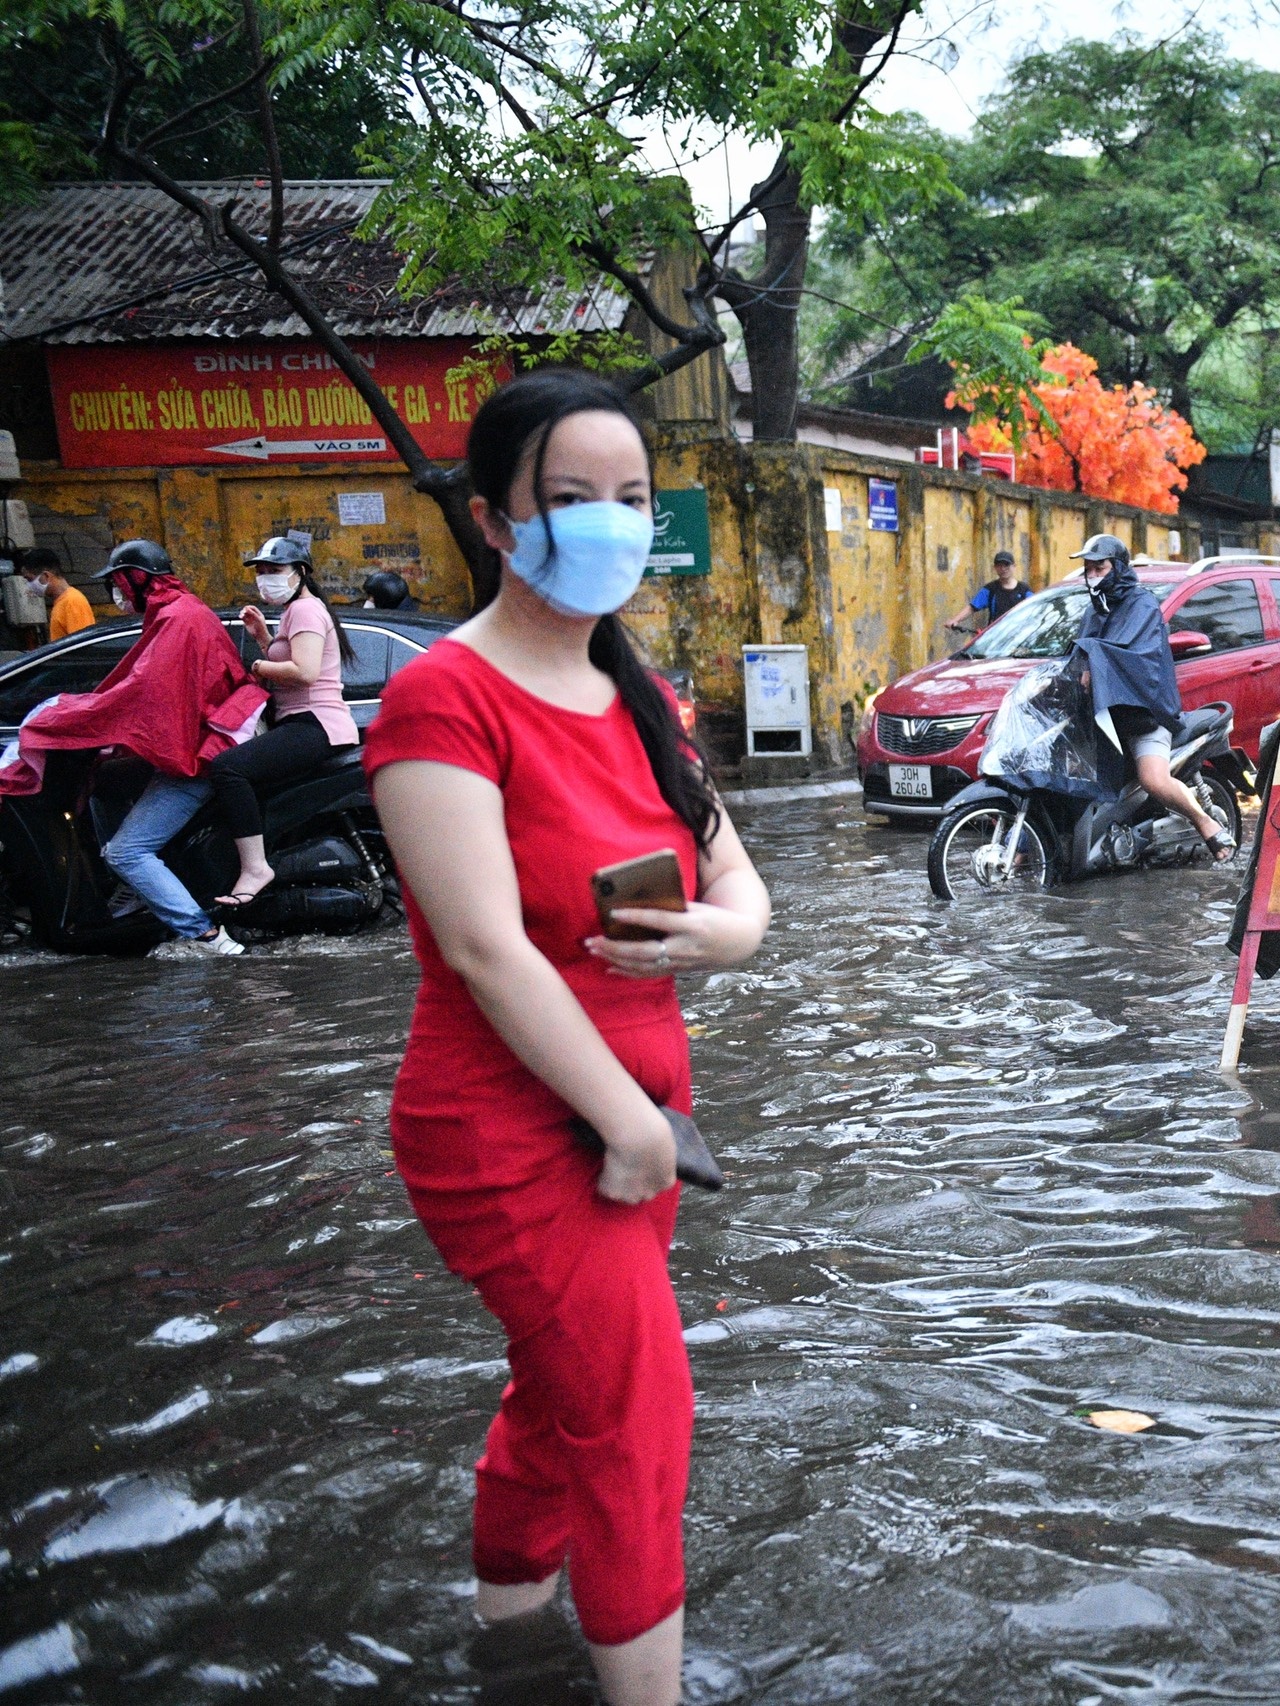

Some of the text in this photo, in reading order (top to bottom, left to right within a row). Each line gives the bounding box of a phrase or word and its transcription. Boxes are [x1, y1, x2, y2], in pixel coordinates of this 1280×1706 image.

[193, 352, 376, 372] ĐÌNH CHIN
[70, 382, 154, 432] CHUYÊN:
[157, 377, 200, 431] SỬA
[201, 381, 261, 432] CHỮA,
[262, 375, 303, 428] BẢO
[306, 378, 373, 427] DƯỠNG
[404, 384, 431, 424] GA
[446, 383, 472, 423] XE
[357, 440, 380, 450] 5M
[900, 767, 920, 781] 30H
[894, 781, 928, 796] 260.48
